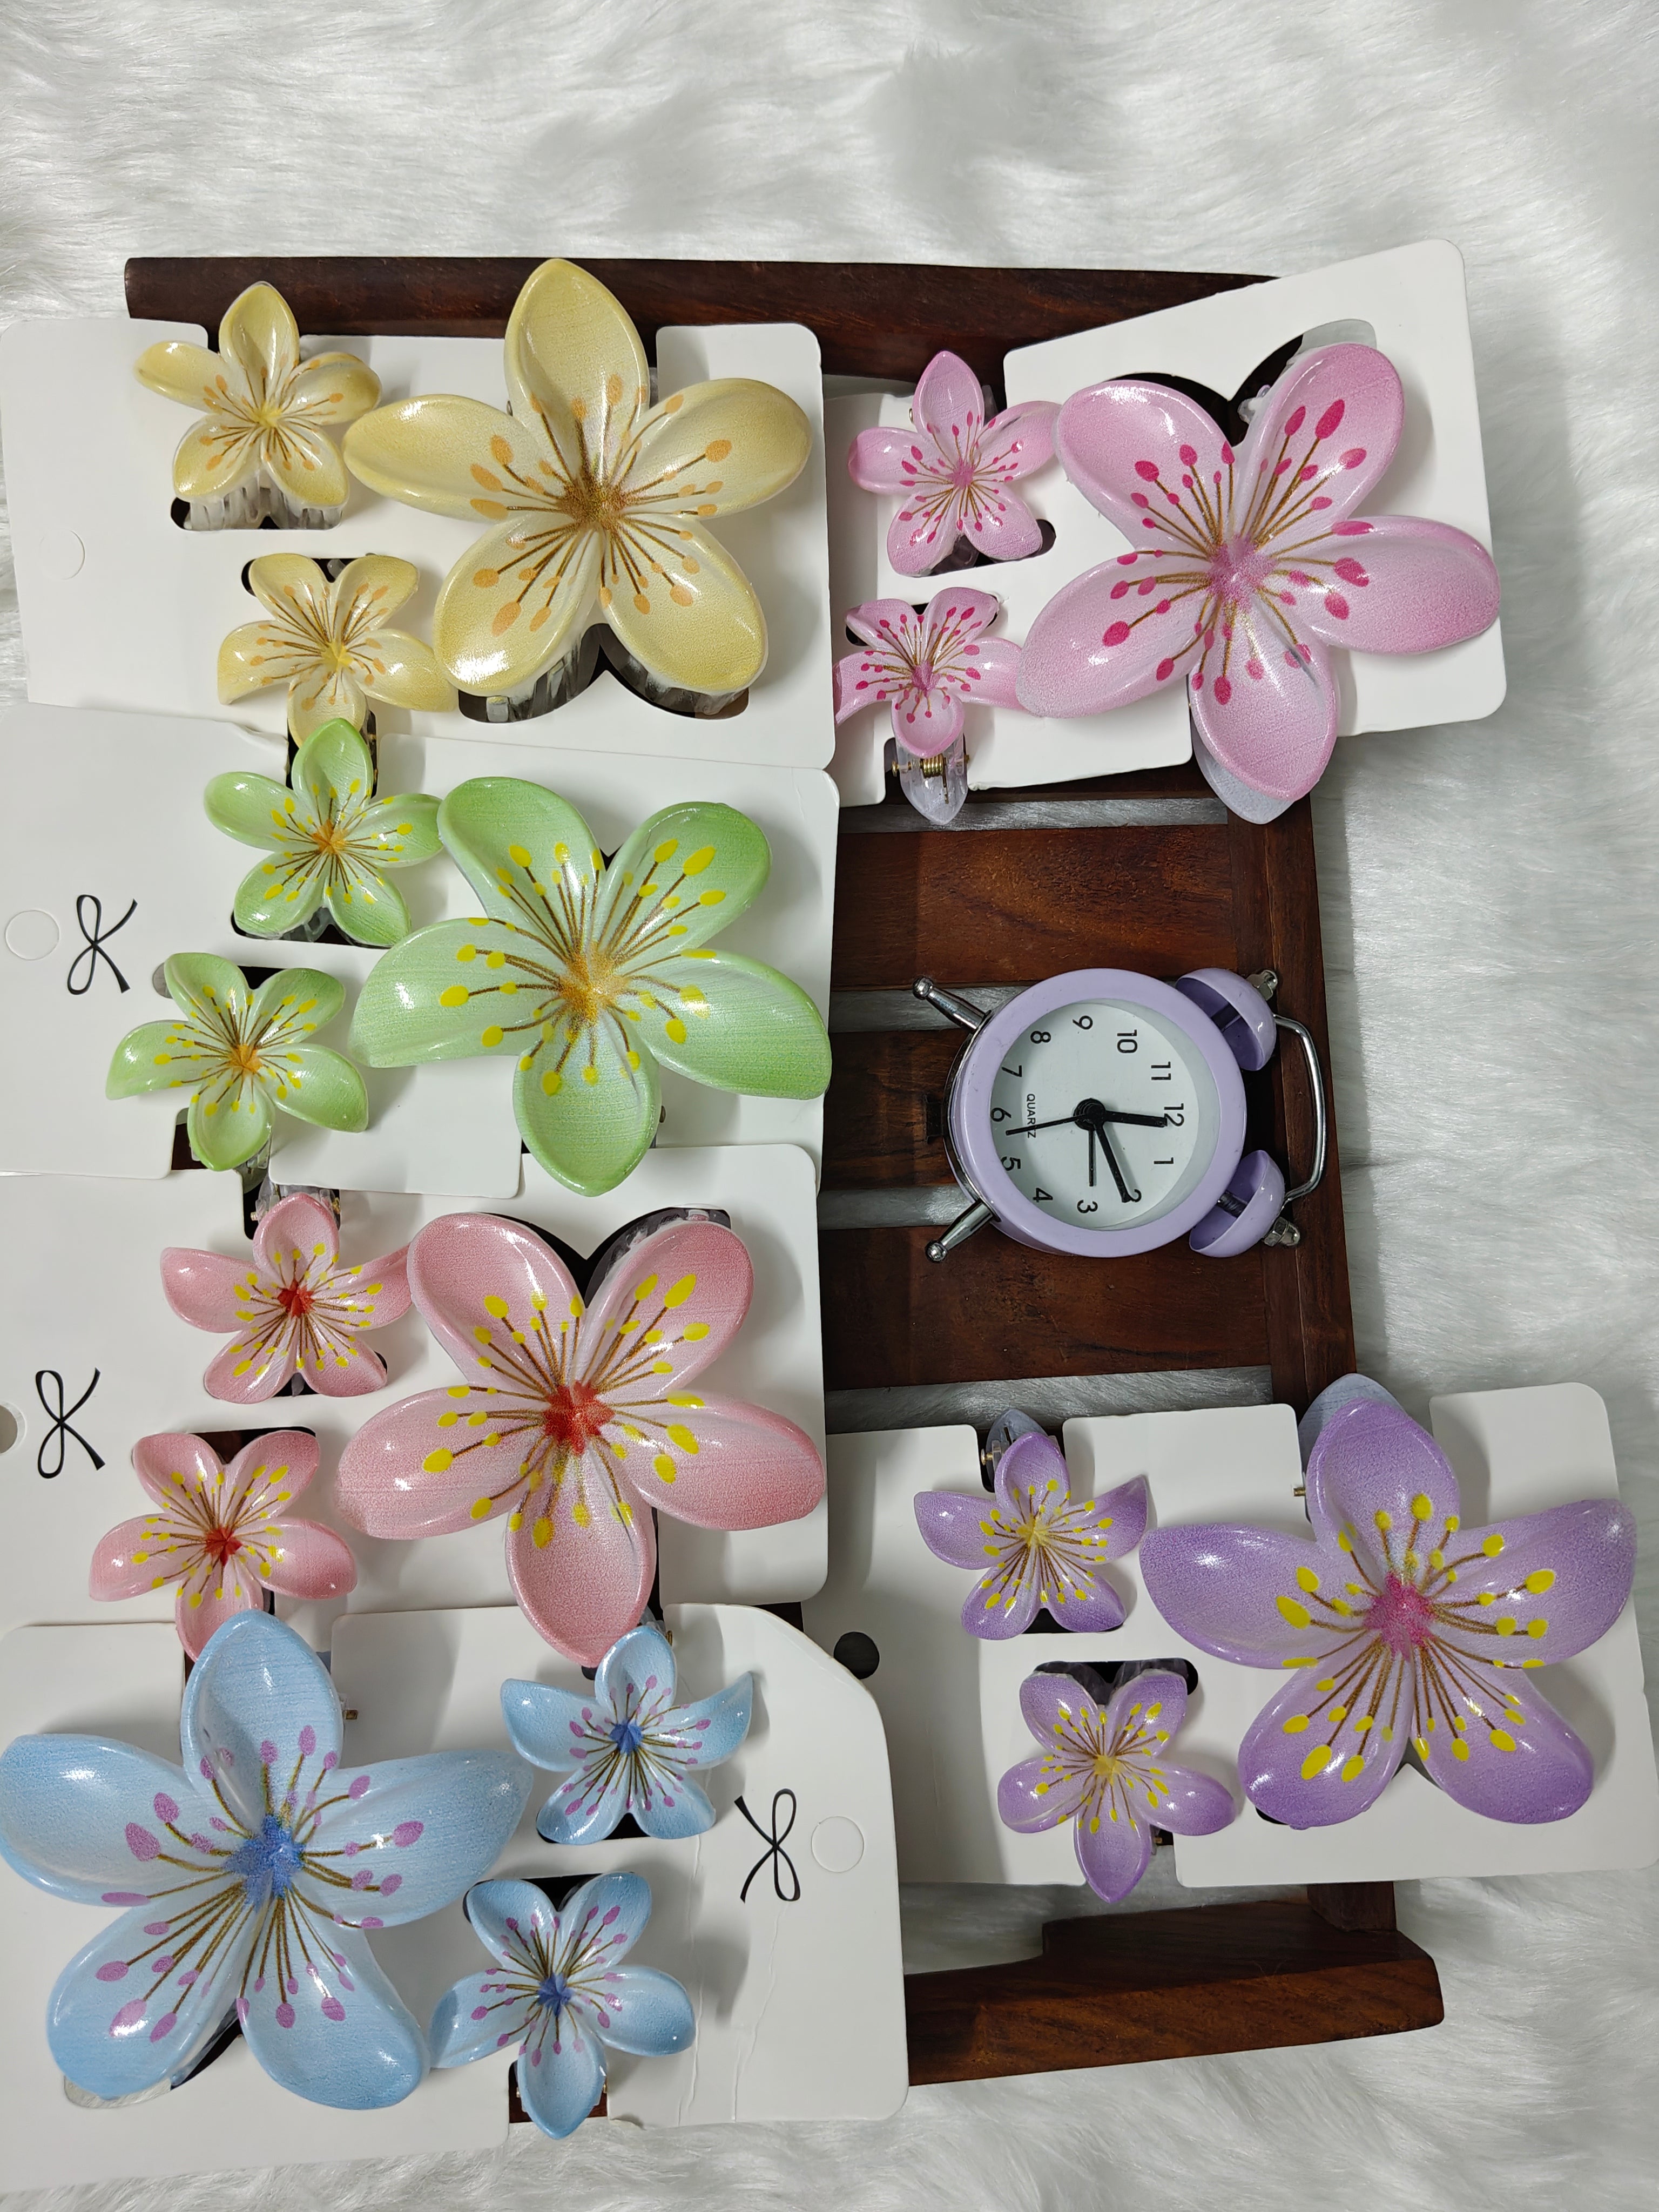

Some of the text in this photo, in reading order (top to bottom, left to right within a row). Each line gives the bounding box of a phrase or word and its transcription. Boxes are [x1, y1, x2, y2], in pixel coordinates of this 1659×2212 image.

[1072, 1015, 1093, 1030] 9
[1030, 1030, 1051, 1044] 8
[1117, 1029, 1138, 1054] 10
[1001, 1065, 1023, 1077] 7
[1151, 1061, 1171, 1081] 11
[990, 1107, 1011, 1122] 6
[1164, 1103, 1185, 1127] 12
[1000, 1156, 1021, 1172] 5
[1032, 1187, 1053, 1203] 4
[1076, 1199, 1098, 1214] 3
